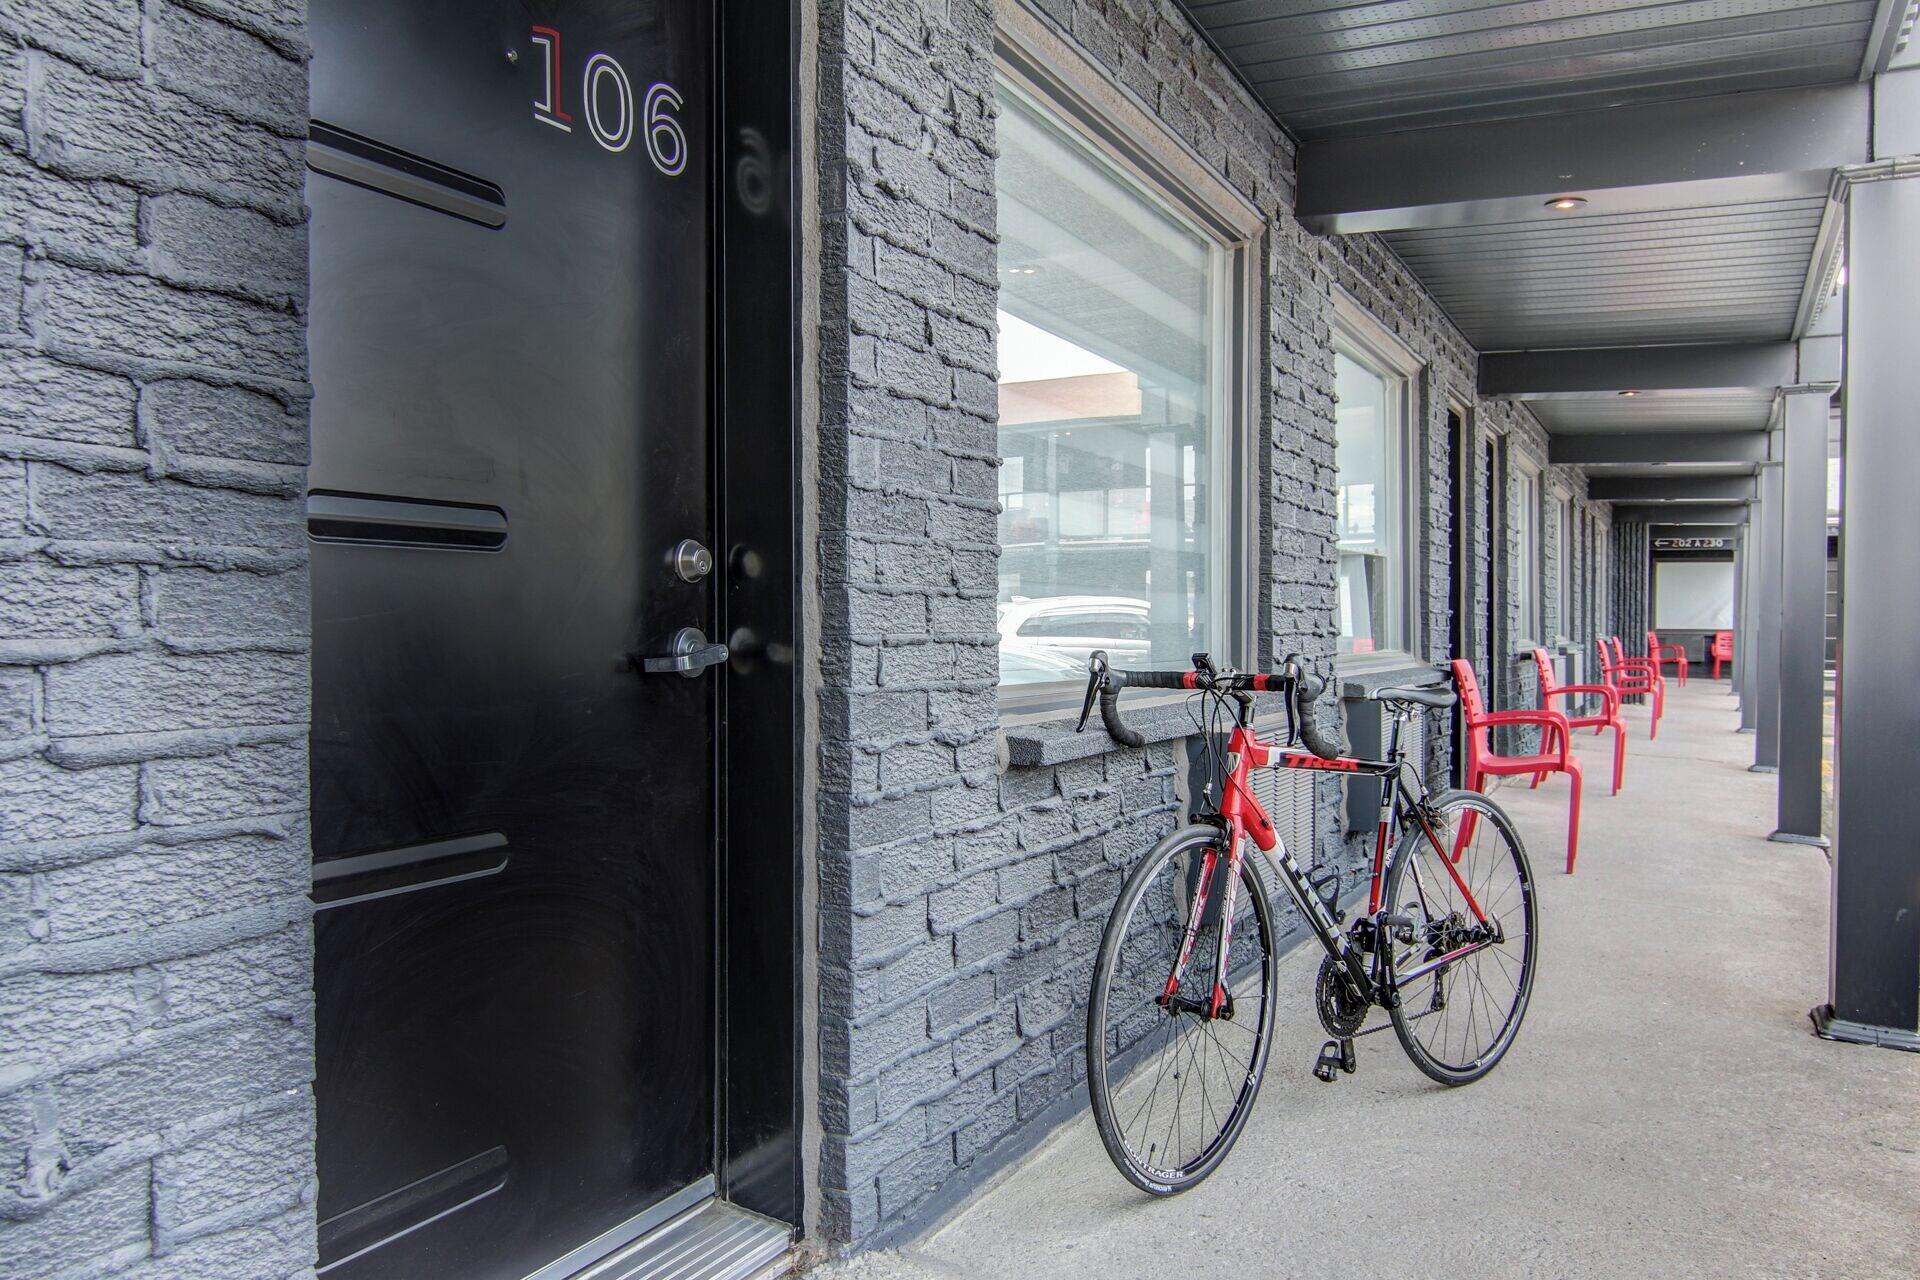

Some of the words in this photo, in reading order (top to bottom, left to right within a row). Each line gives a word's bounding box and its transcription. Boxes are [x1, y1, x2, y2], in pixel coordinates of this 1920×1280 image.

[531, 25, 688, 176] 106
[1672, 539, 1692, 548] 202
[1703, 539, 1724, 548] 230
[1285, 753, 1358, 772] TREK
